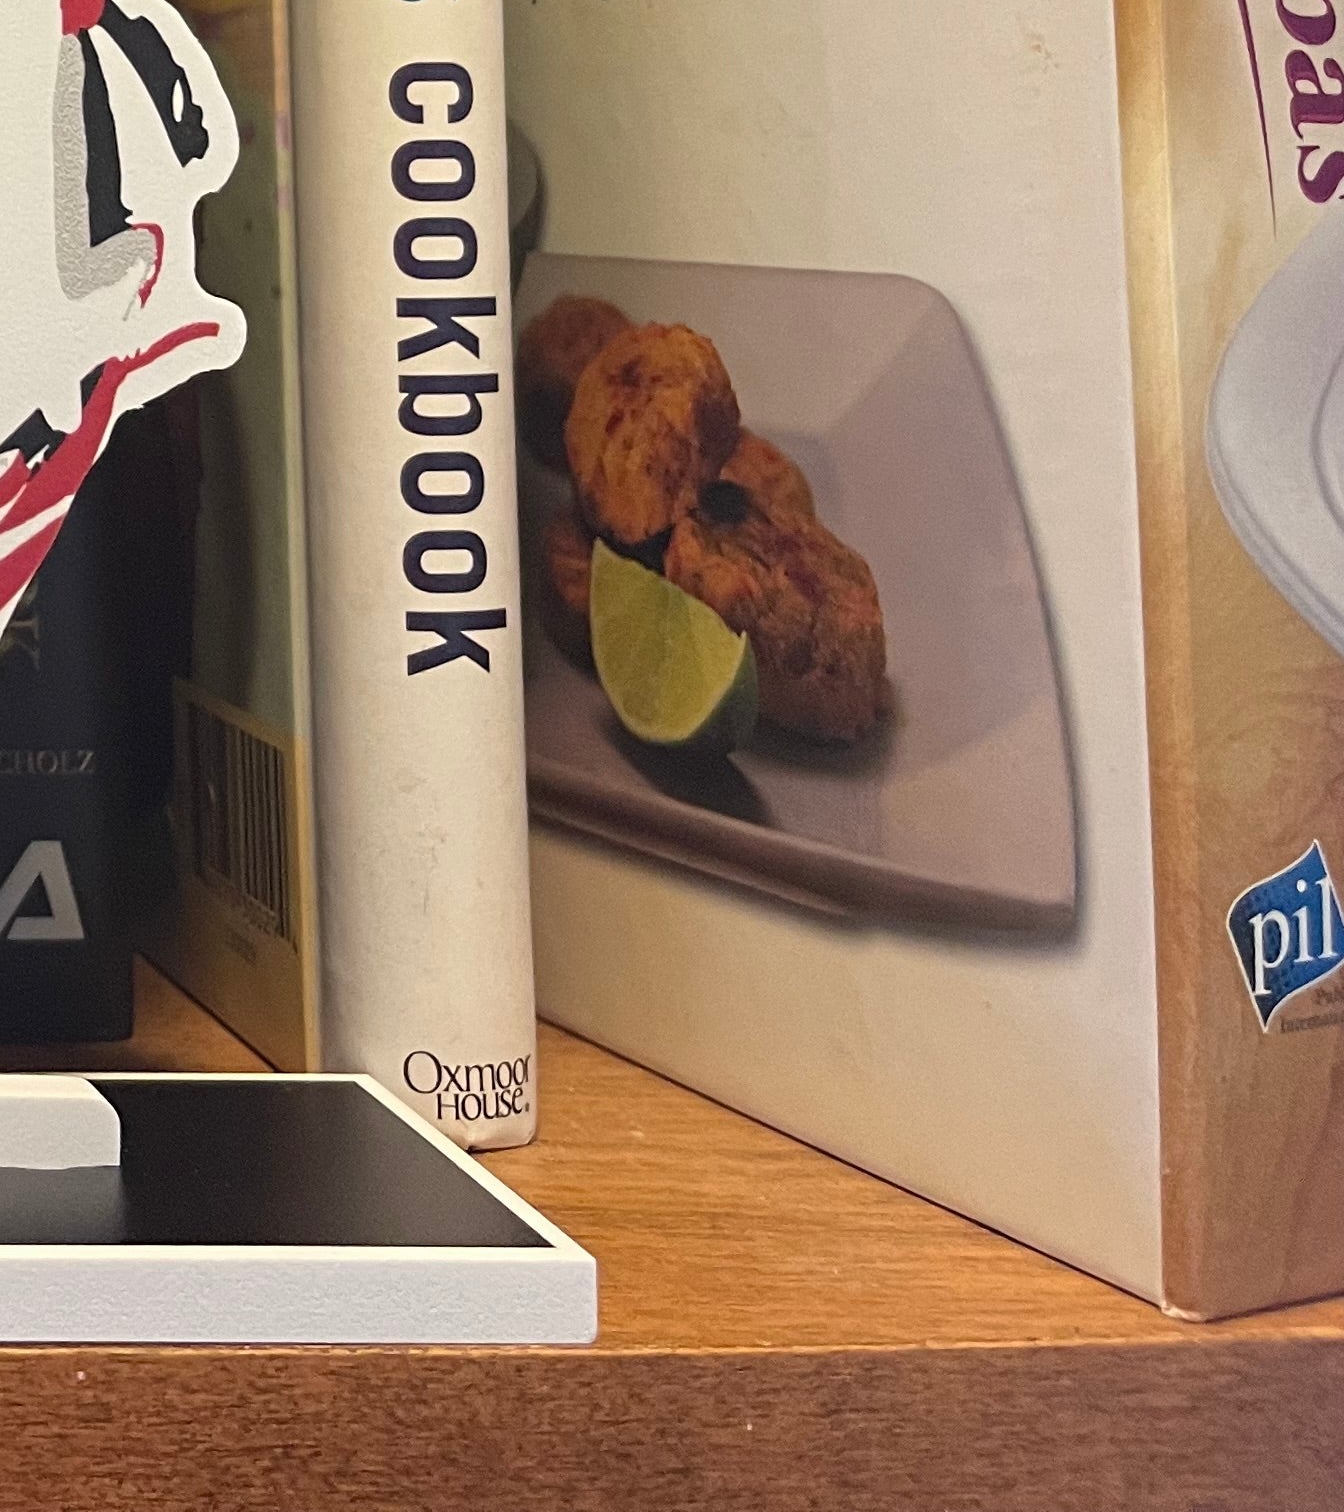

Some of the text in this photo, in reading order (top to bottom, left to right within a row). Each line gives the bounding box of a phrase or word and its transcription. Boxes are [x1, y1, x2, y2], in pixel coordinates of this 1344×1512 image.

[388, 61, 508, 676] cookbook
[1248, 877, 1340, 996] pil
[403, 1050, 531, 1094] Oxmoor
